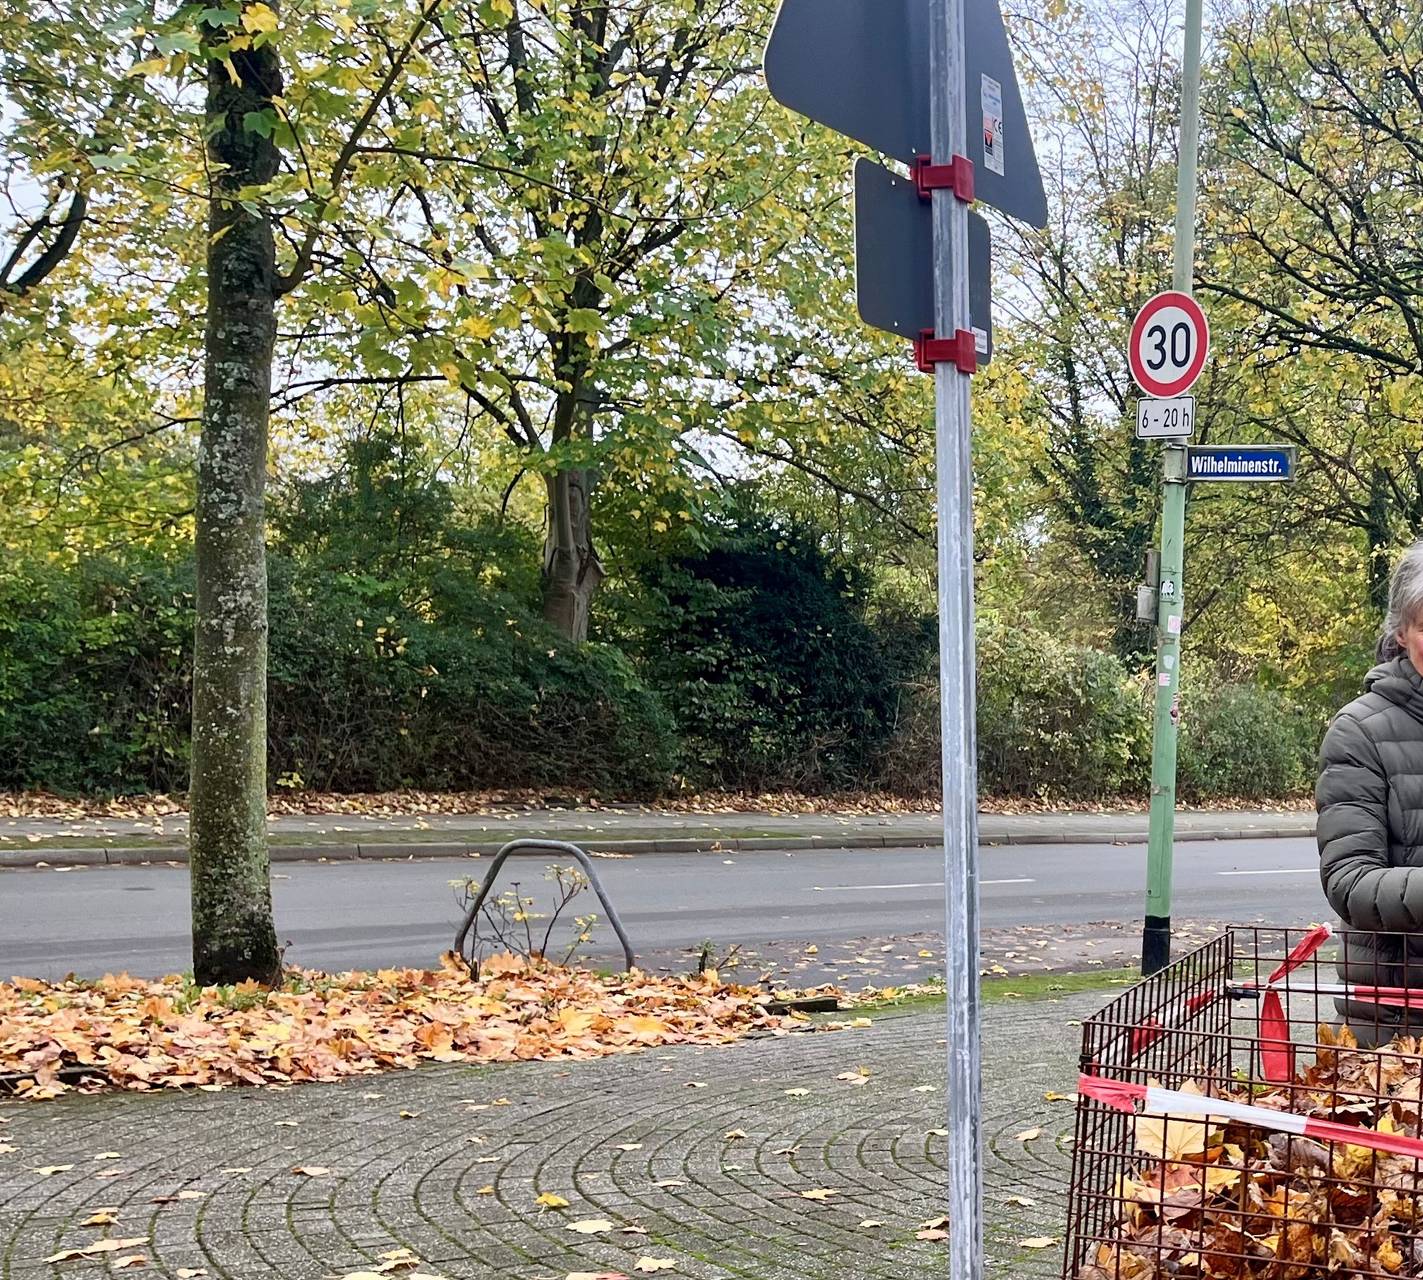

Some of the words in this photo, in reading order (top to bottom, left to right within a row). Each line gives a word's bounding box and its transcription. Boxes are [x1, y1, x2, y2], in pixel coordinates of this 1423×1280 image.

[1147, 322, 1191, 370] 30
[1142, 409, 1149, 428] 6
[1163, 408, 1178, 427] 20
[1182, 408, 1189, 427] h
[1191, 456, 1282, 473] Wilhelminenstr.
